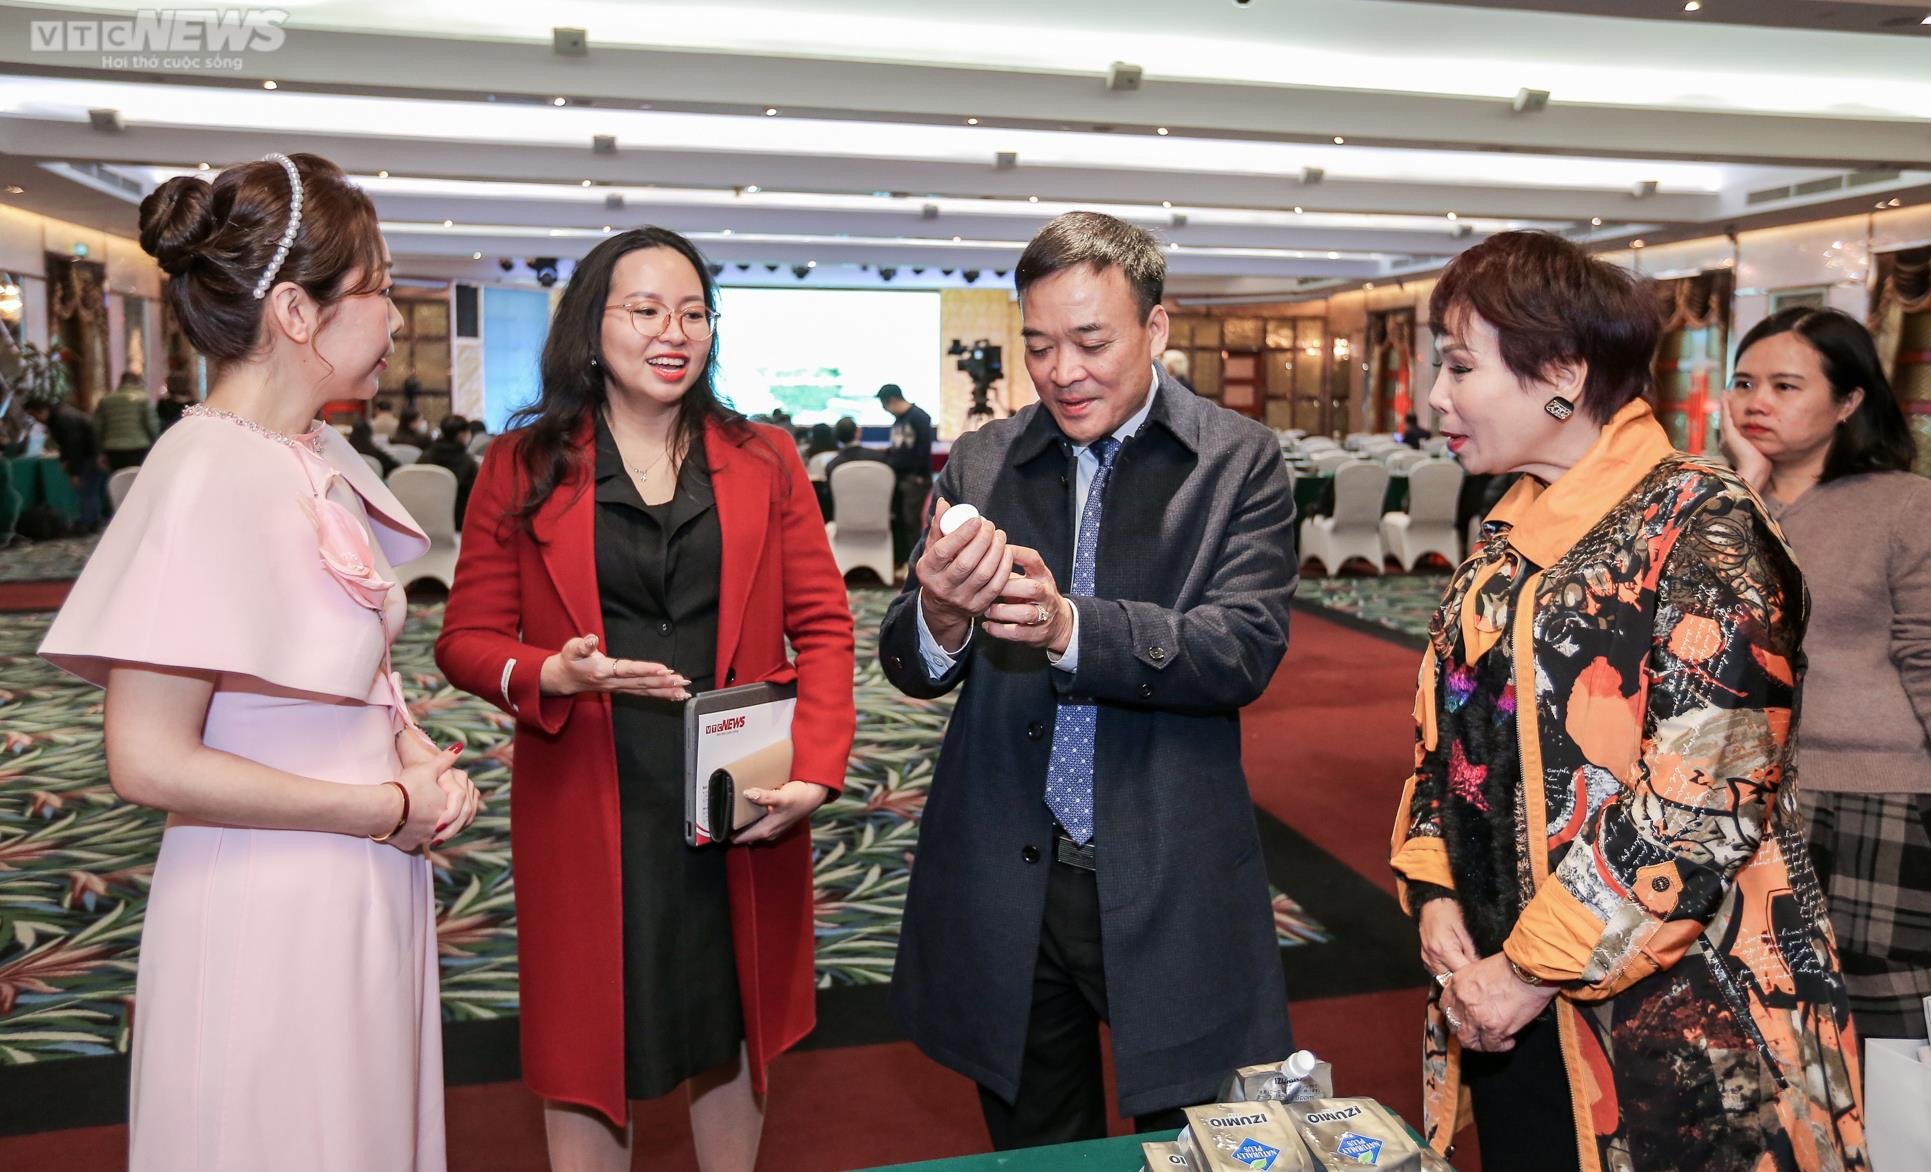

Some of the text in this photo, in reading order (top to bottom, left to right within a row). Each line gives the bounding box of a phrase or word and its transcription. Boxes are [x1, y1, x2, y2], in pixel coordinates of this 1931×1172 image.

[1209, 1113, 1268, 1127] IZUMIO
[1307, 1105, 1362, 1124] IZUMIO
[1346, 1138, 1366, 1147] PLUS
[1236, 1149, 1278, 1160] NATURALLY
[1243, 1145, 1263, 1153] PLUS
